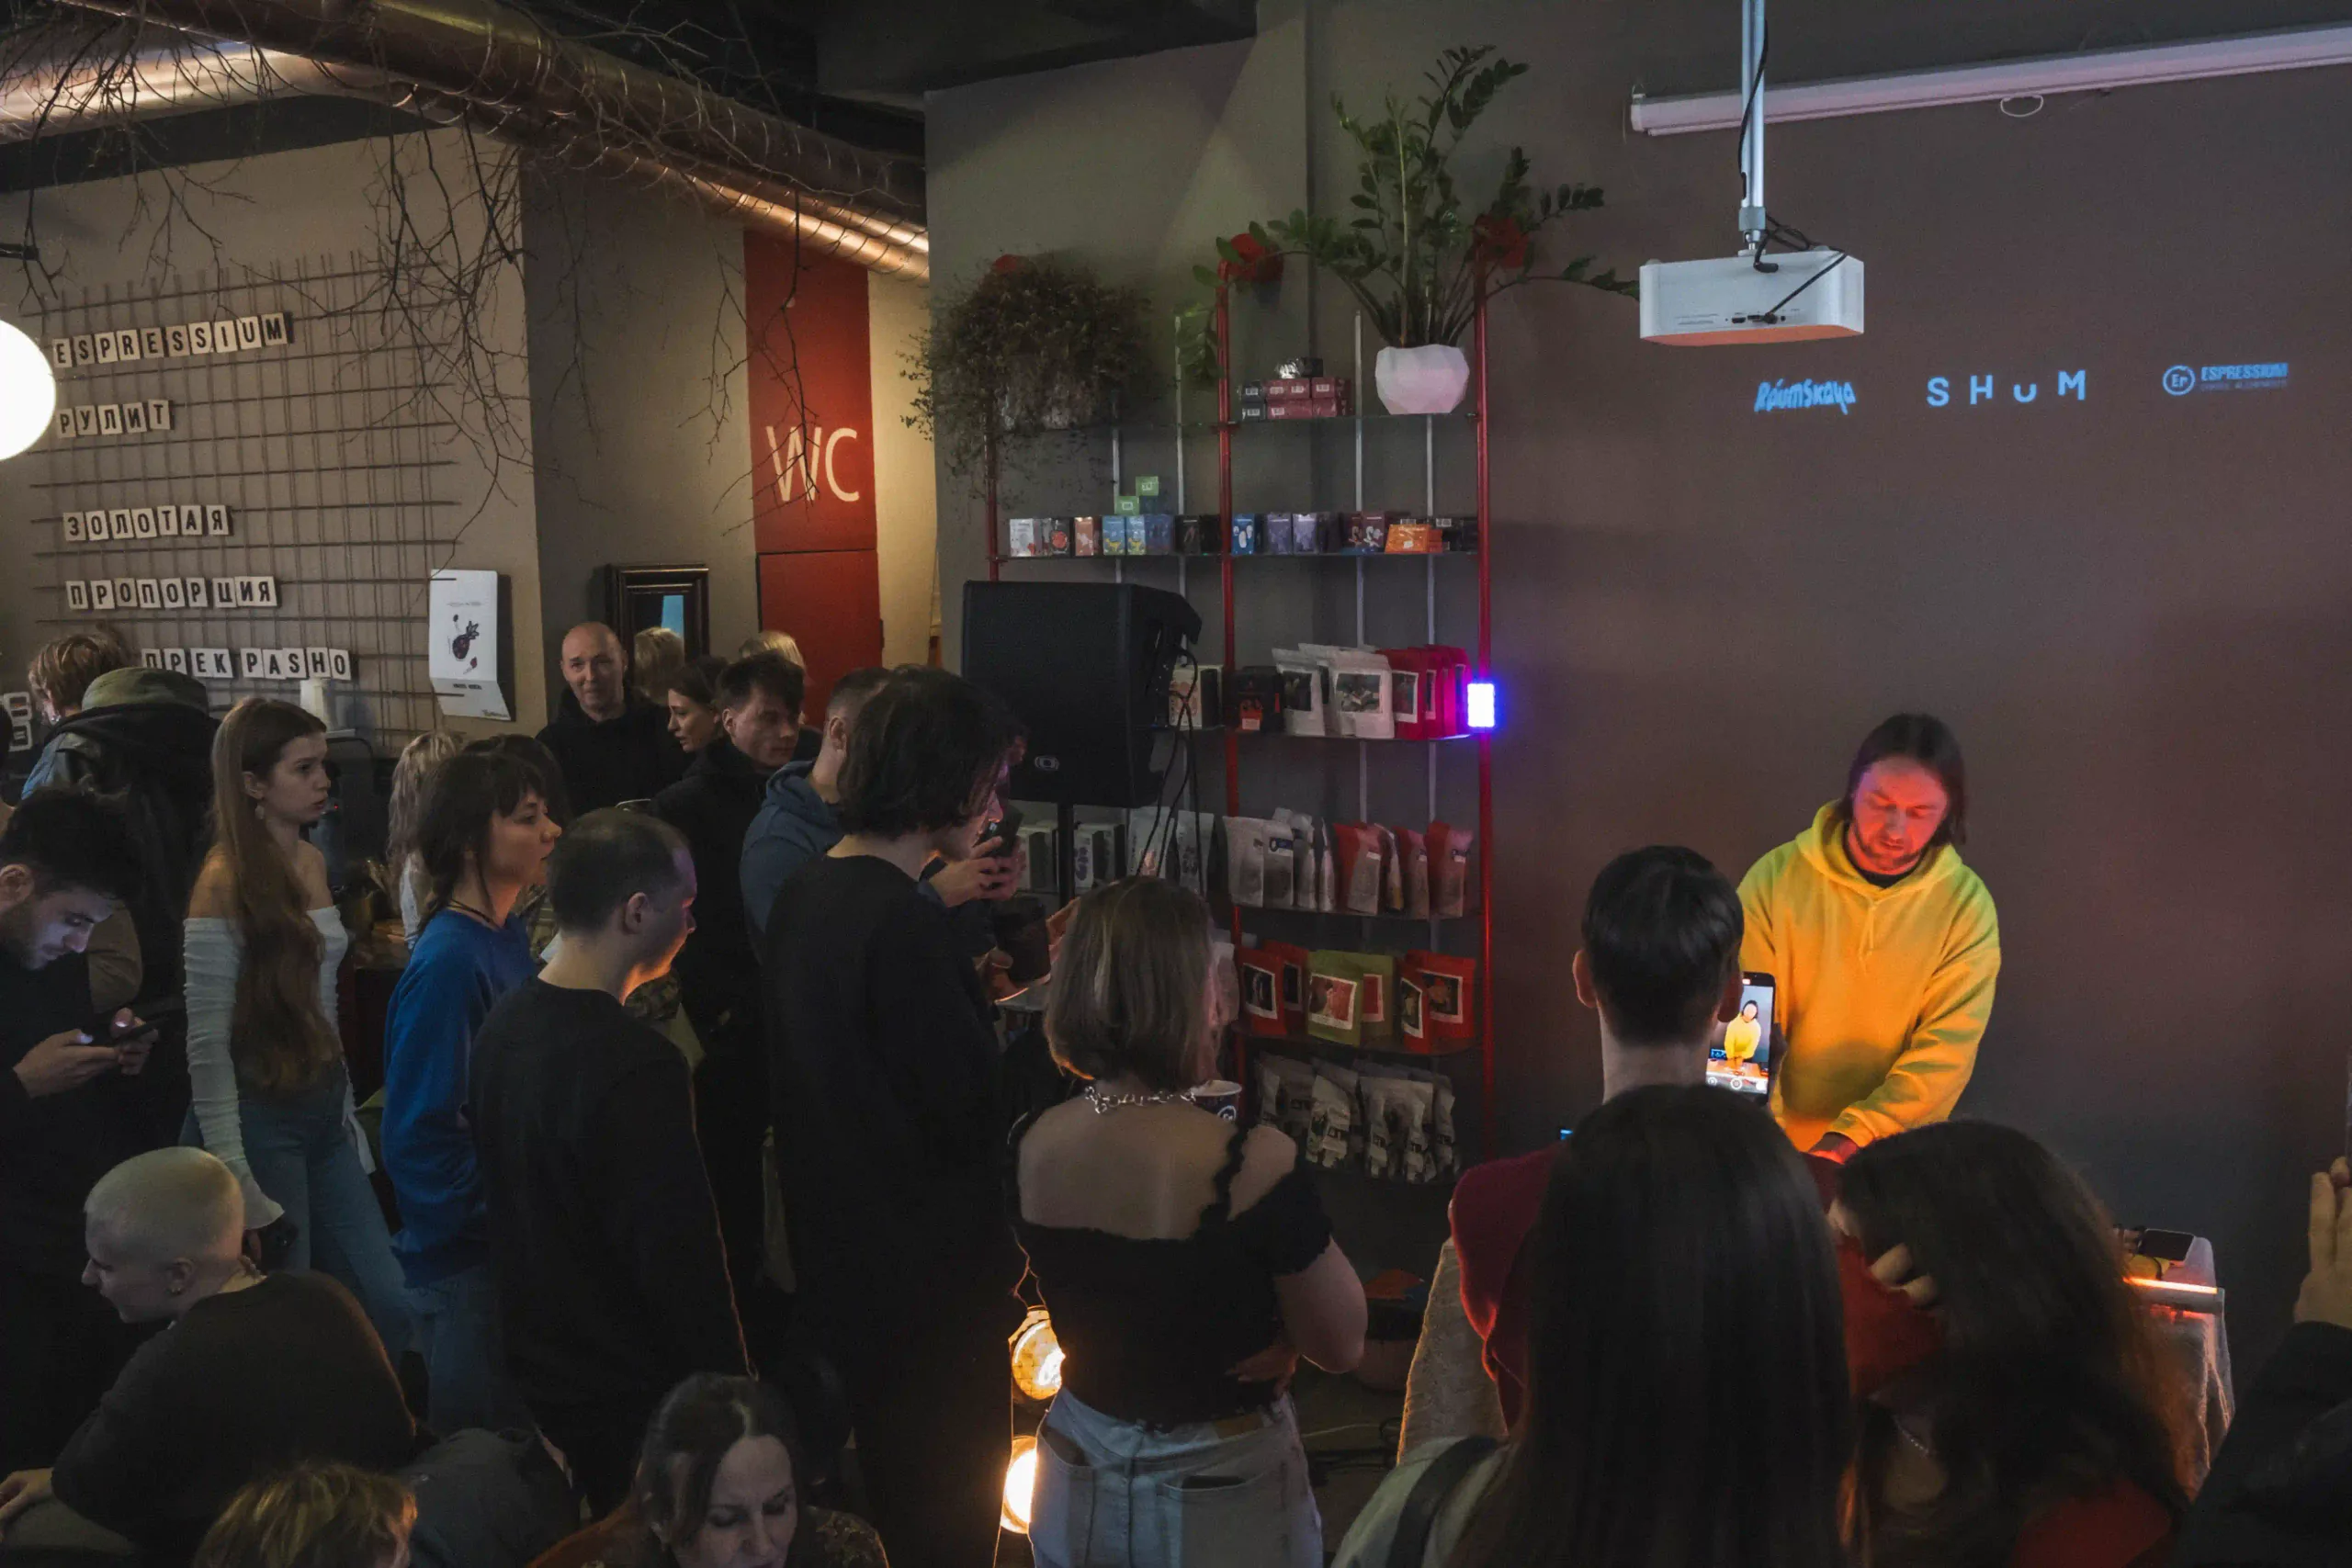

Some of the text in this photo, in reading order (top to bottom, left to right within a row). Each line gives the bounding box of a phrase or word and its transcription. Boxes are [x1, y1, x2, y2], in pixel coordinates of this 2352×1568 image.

[56, 319, 282, 357] ESPRESSIUM
[60, 404, 164, 433] РУЛИТ
[766, 426, 860, 502] WC
[68, 508, 224, 536] ЗОЛОТАЯ
[70, 580, 270, 605] ПРОПОРЦИЯ
